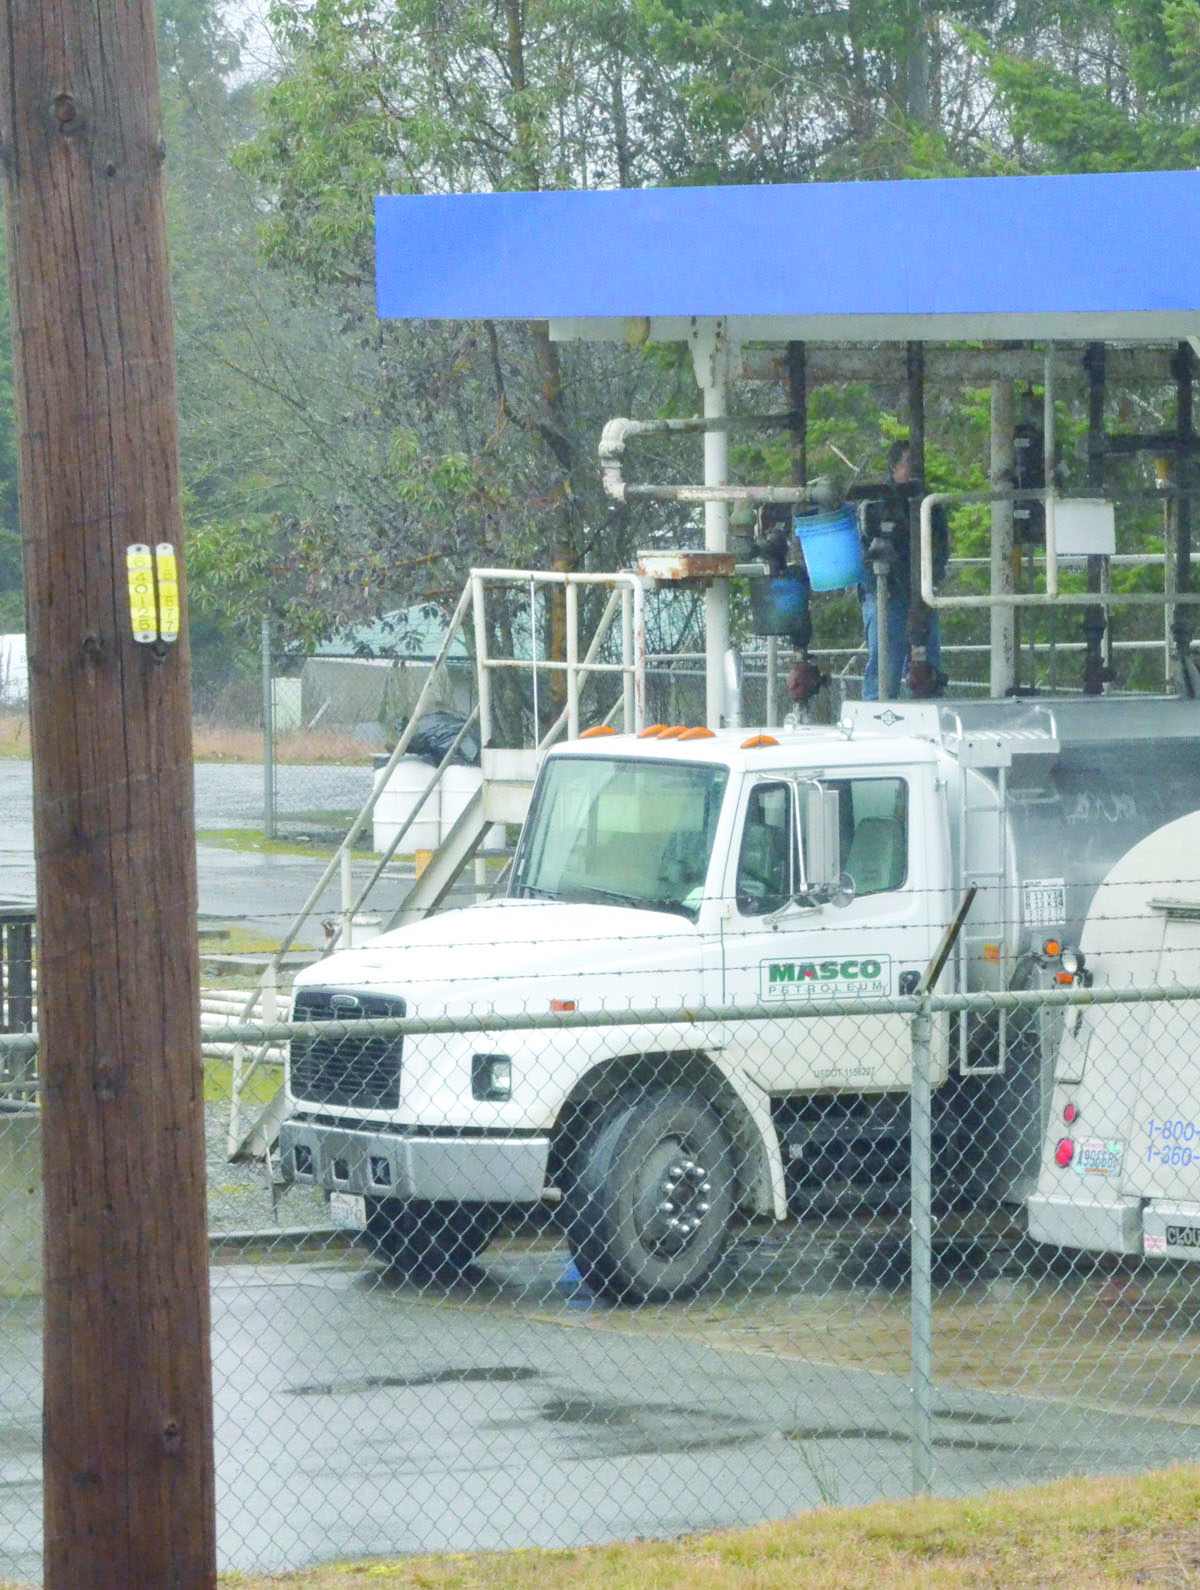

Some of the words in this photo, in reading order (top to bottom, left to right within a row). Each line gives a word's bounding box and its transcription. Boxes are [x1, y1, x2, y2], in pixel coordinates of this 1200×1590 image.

[769, 959, 881, 982] MASCO
[769, 983, 882, 995] PETROLEUM
[815, 1069, 841, 1079] USDOT
